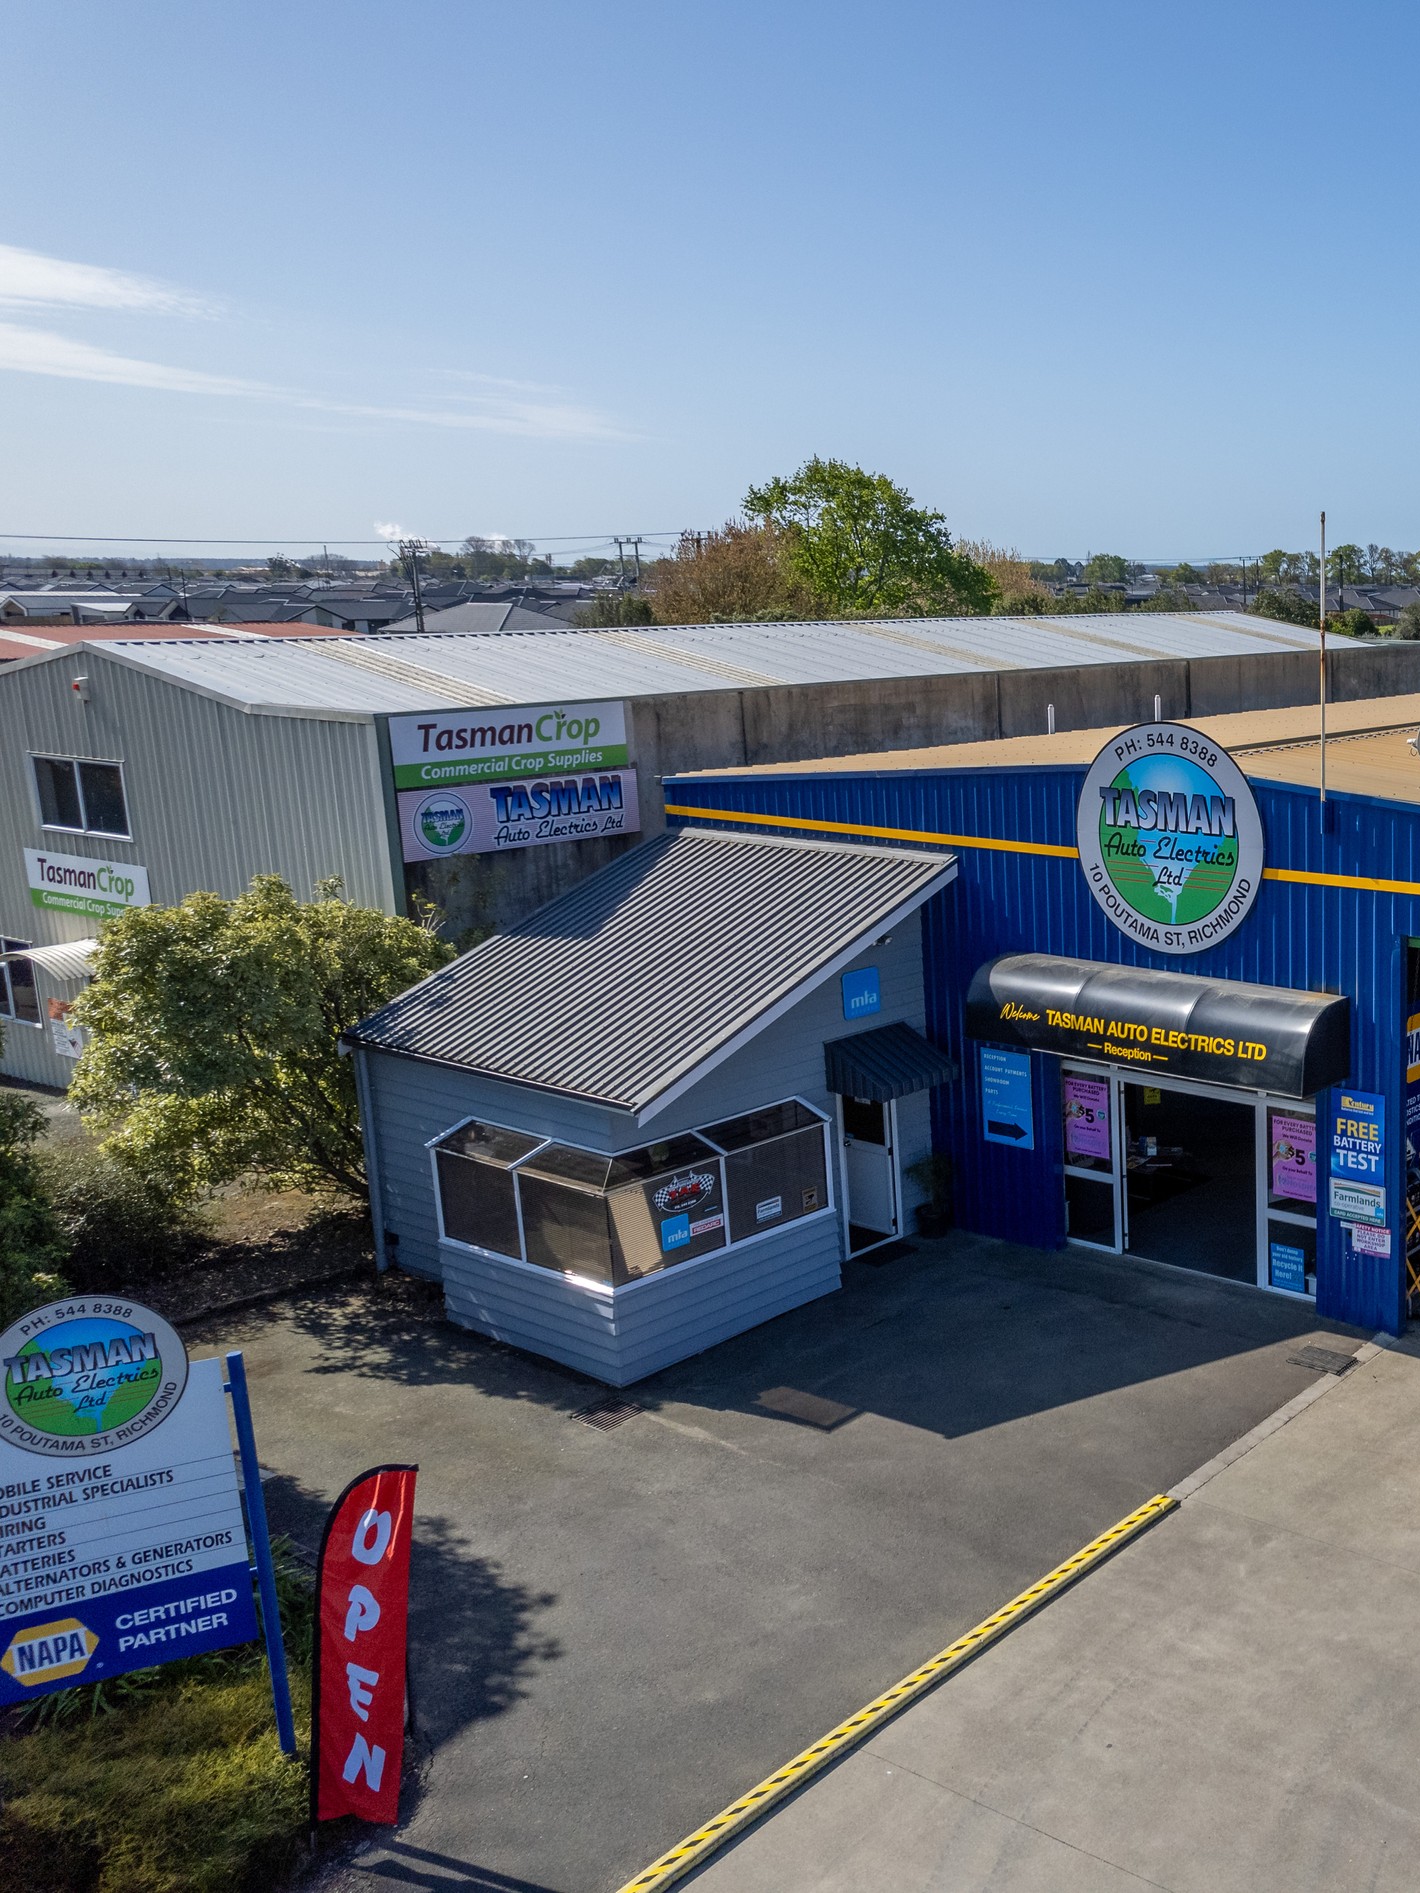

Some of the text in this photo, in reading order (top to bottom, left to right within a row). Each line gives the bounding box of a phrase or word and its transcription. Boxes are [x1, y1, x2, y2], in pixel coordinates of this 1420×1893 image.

[417, 710, 600, 752] TasmanCrop
[421, 750, 603, 780] Commercial Crop Supplies
[1115, 733, 1218, 768] PH: 544 8388
[489, 775, 623, 823] TASMAN
[1100, 787, 1236, 837] TASMAN
[494, 814, 624, 847] Auto Electrics Ltd
[1104, 832, 1234, 866] Auto Electrics
[37, 858, 134, 902] TasmanCrop
[1152, 867, 1184, 887] Ltd
[42, 892, 86, 910] Commercial
[87, 900, 105, 916] Crop
[1089, 863, 1251, 949] 10 POUTAMA ST, RICHMOND
[851, 990, 877, 1009] mta
[1000, 1001, 1267, 1061] Welcome TASMAN AUTO ELECTRICS LTD
[1104, 1041, 1152, 1062] Reception
[1406, 1096, 1417, 1106] TED
[1281, 1125, 1313, 1136] PURCHASED
[1333, 1135, 1382, 1154] BATTERY
[1336, 1117, 1379, 1141] FREE
[1287, 1145, 1306, 1166] $5
[1336, 1148, 1379, 1172] TEST
[1333, 1209, 1346, 1217] CARD
[1346, 1211, 1369, 1221] ACCEPTED
[1334, 1191, 1381, 1208] Farmlands
[667, 1229, 688, 1243] mta
[1272, 1258, 1297, 1270] Recycle
[20, 1303, 133, 1336] PH: 544 8388
[3, 1332, 160, 1385] TASMAN
[13, 1367, 159, 1406] Auto Electrics
[73, 1391, 107, 1413] Ltd
[0, 1381, 178, 1451] 10 POUTAMA ST, RICHMOND
[46, 1464, 112, 1489] SERVICE
[82, 1469, 174, 1500] SPECIALISTS
[116, 1556, 127, 1569] &
[131, 1531, 233, 1565] GENERATORS
[91, 1559, 194, 1594] DIAGNOSTICS
[115, 1588, 238, 1630] CERTIFIED
[118, 1612, 229, 1653] PARTNER
[17, 1631, 85, 1673] NAPA
[342, 1508, 392, 1793] OPEN
